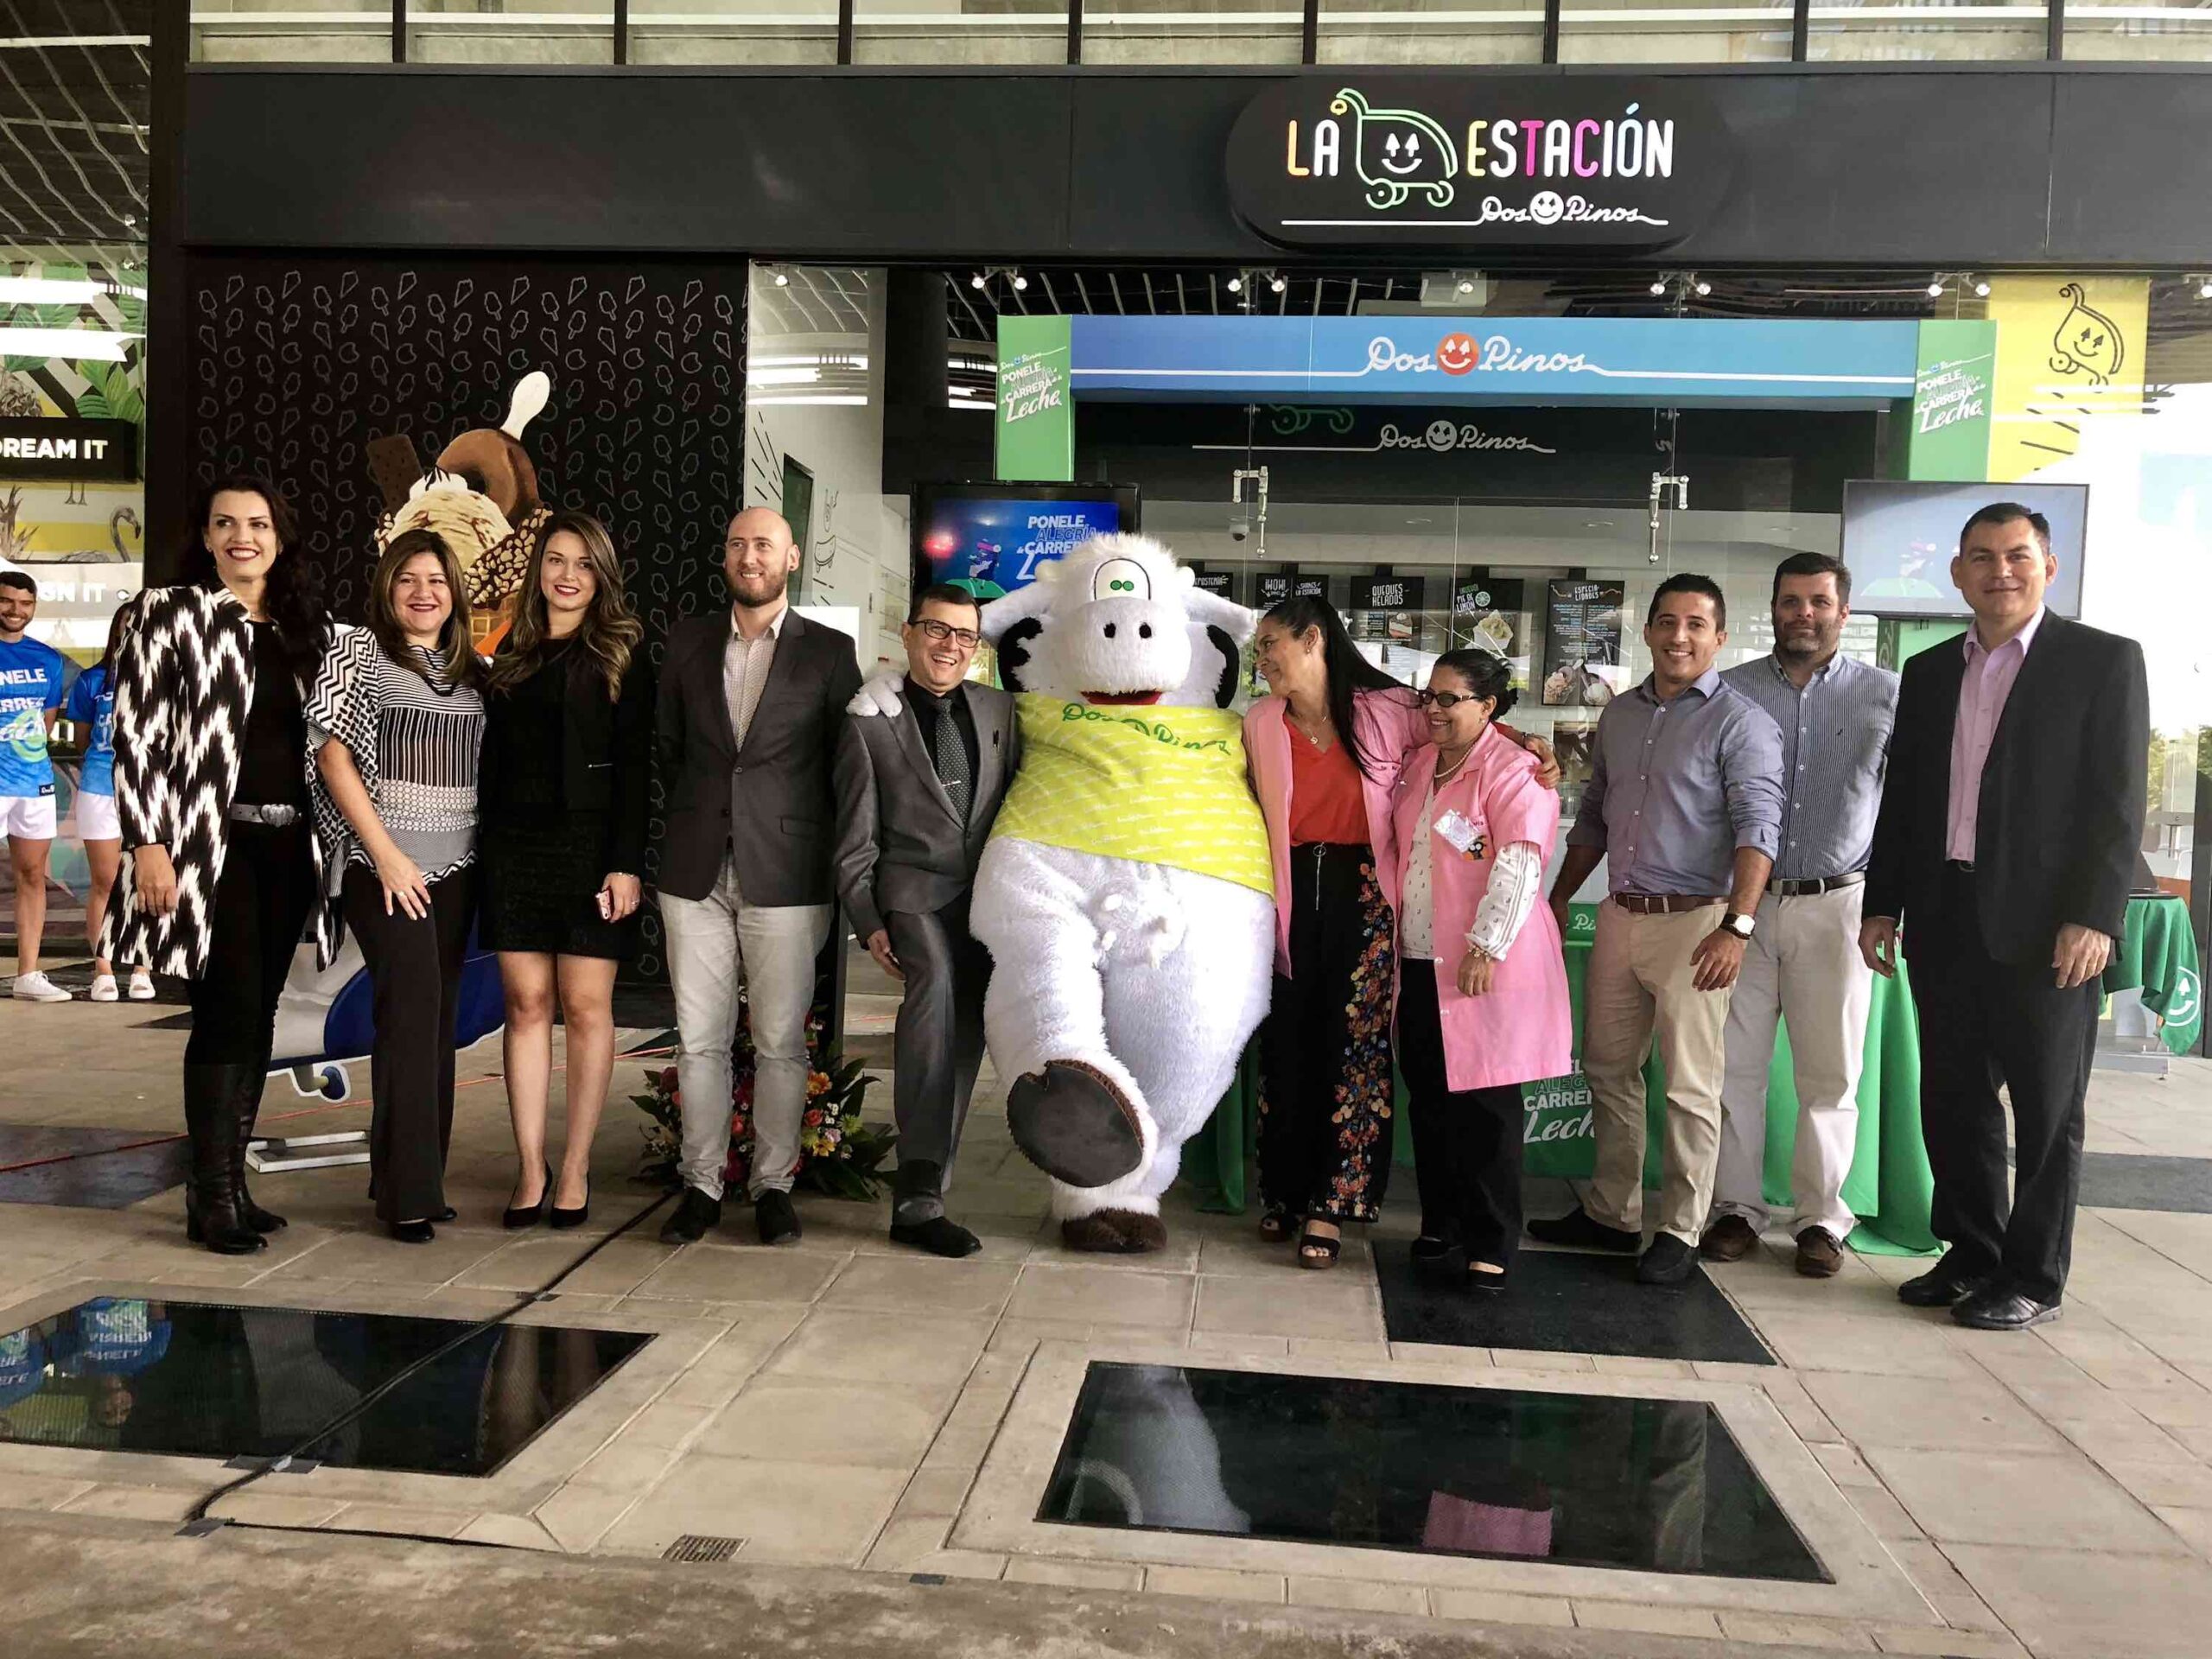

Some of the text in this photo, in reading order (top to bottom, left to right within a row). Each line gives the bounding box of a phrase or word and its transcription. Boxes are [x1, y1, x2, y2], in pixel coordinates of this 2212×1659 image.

[1287, 102, 1675, 177] LA ESTACIÓN
[1480, 194, 1641, 225] Dos Pinos
[1368, 335, 1586, 372] Dos Pinos
[1001, 361, 1042, 385] PONELE
[1916, 368, 1964, 393] PONELE
[1005, 378, 1053, 404] CARRERA
[1920, 385, 1974, 412] CARRERA
[1006, 385, 1063, 423] Leche
[1918, 391, 1985, 434] Leche
[0, 437, 109, 460] REAM IT
[1380, 423, 1530, 449] Dos Pinos
[1027, 514, 1086, 529] PONELE
[1024, 541, 1080, 554] CARRE
[1372, 584, 1403, 595] QUEQUES
[1372, 594, 1403, 607] HELADOS
[1535, 1075, 1589, 1095] ALEG
[1523, 1090, 1592, 1112] CARRE
[1523, 1109, 1595, 1143] Lech
